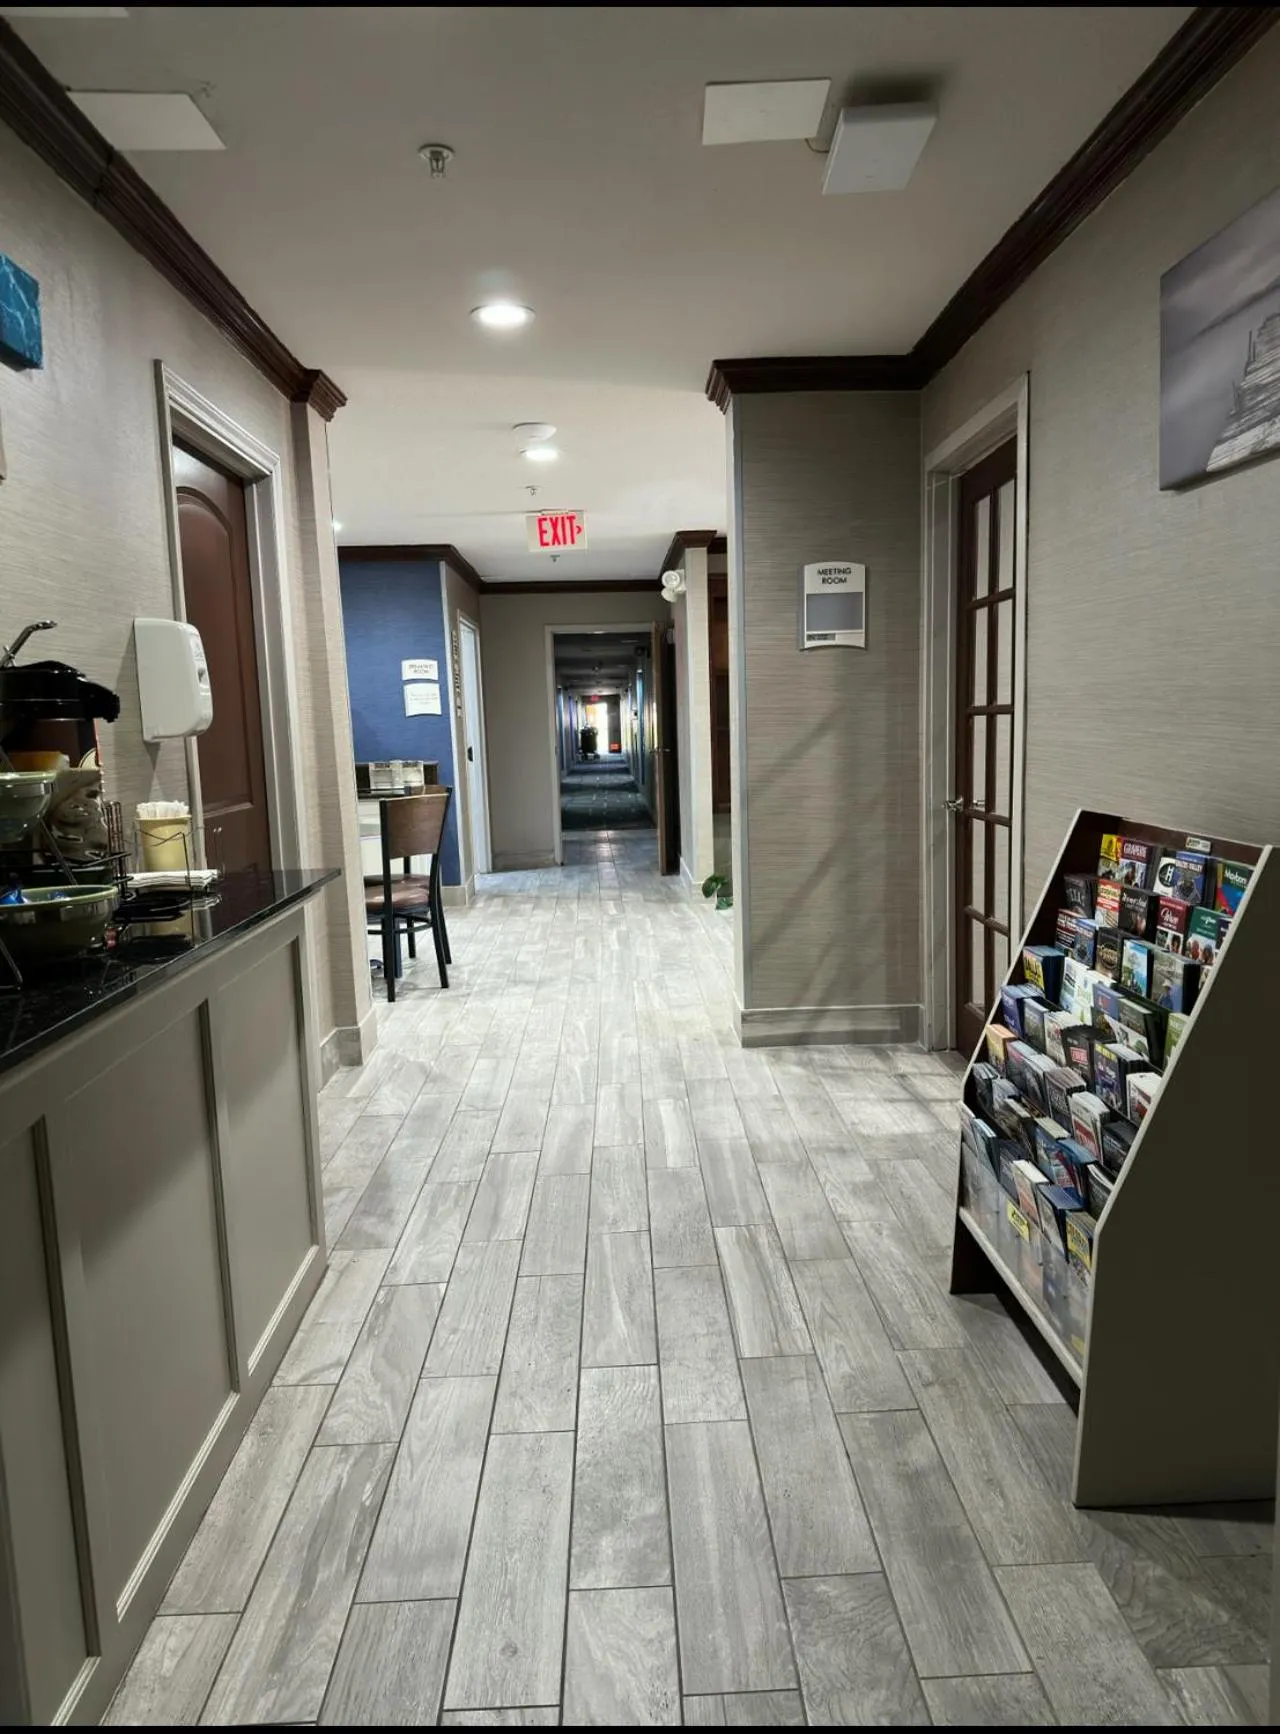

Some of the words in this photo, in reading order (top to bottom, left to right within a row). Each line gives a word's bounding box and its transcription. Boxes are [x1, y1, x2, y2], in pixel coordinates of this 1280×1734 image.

[538, 515, 576, 546] EXIT
[817, 567, 852, 576] MEETING
[821, 576, 848, 585] ROOM
